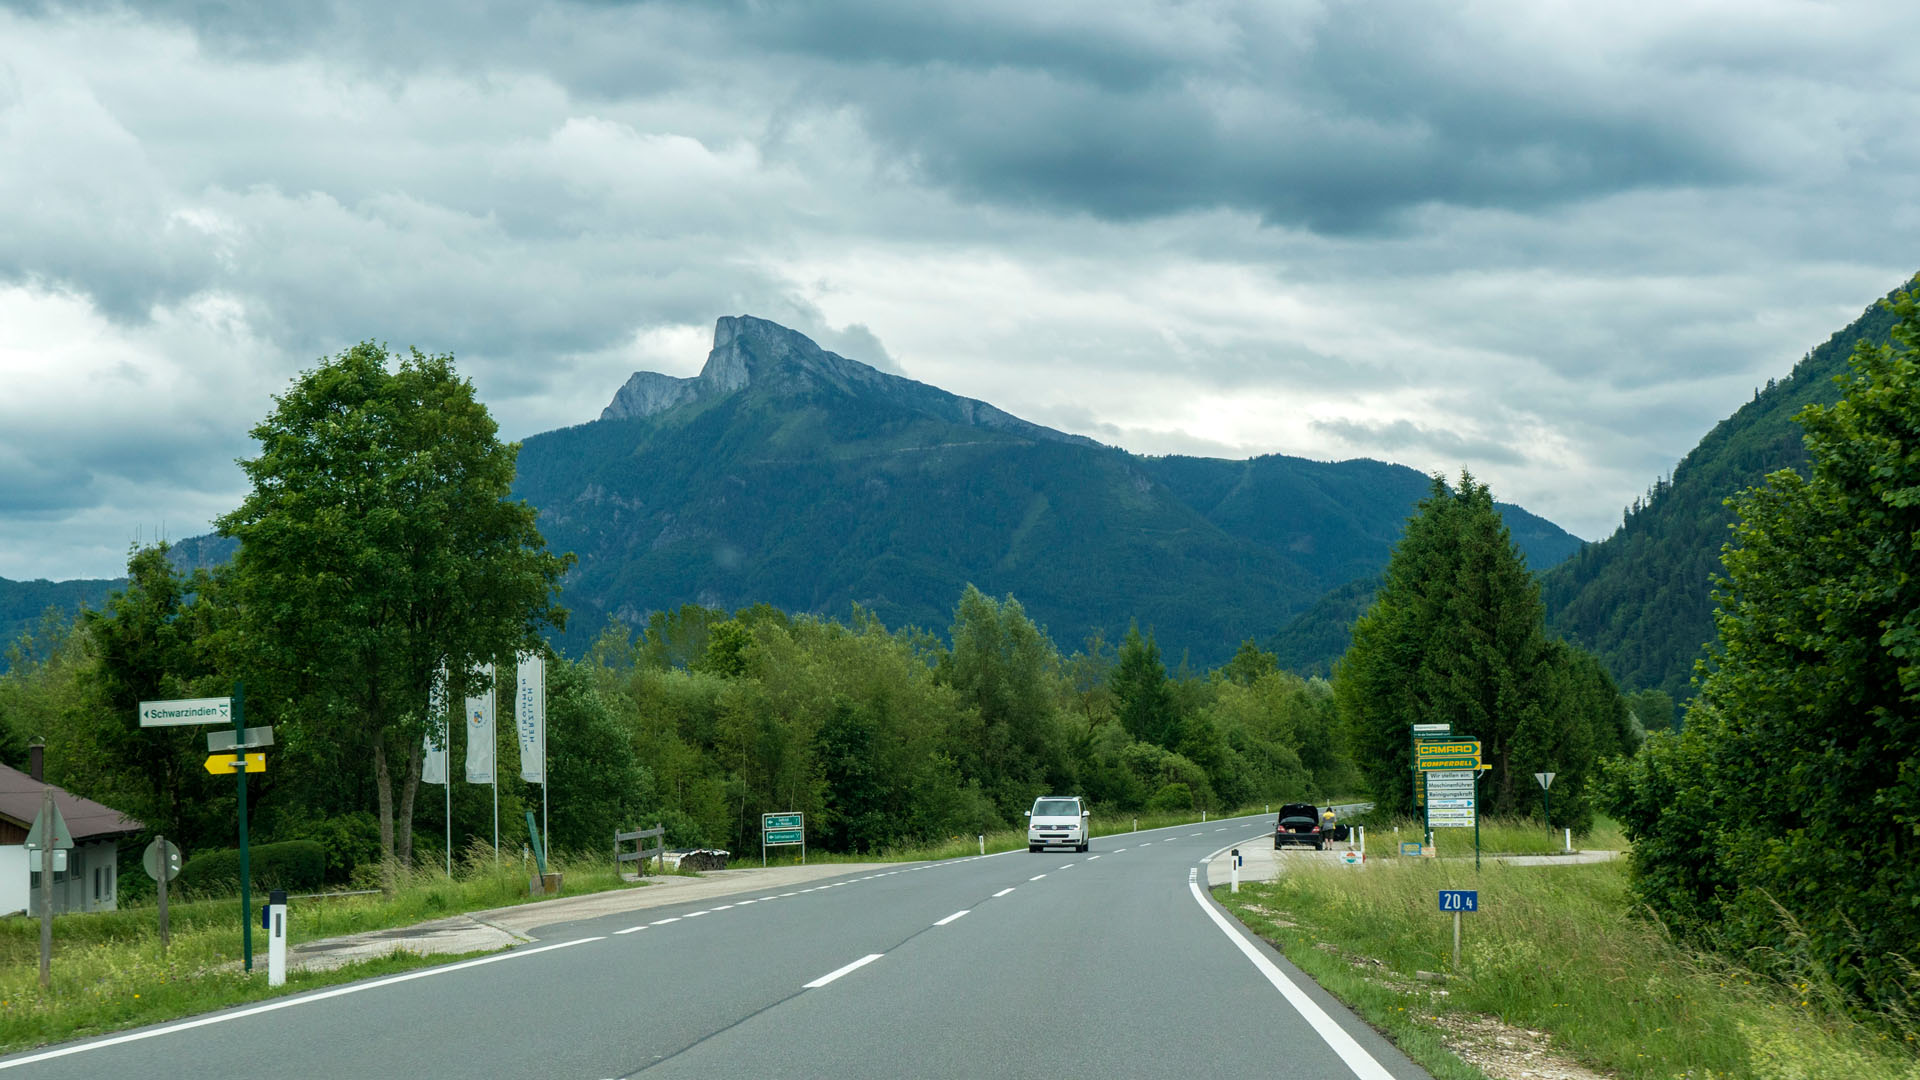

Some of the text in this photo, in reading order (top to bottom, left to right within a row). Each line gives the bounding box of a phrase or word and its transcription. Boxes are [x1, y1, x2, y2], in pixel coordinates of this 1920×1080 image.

[150, 706, 217, 719] Schwarzindien
[1420, 744, 1473, 754] CAMARO
[1421, 760, 1473, 768] KOMPERDELL
